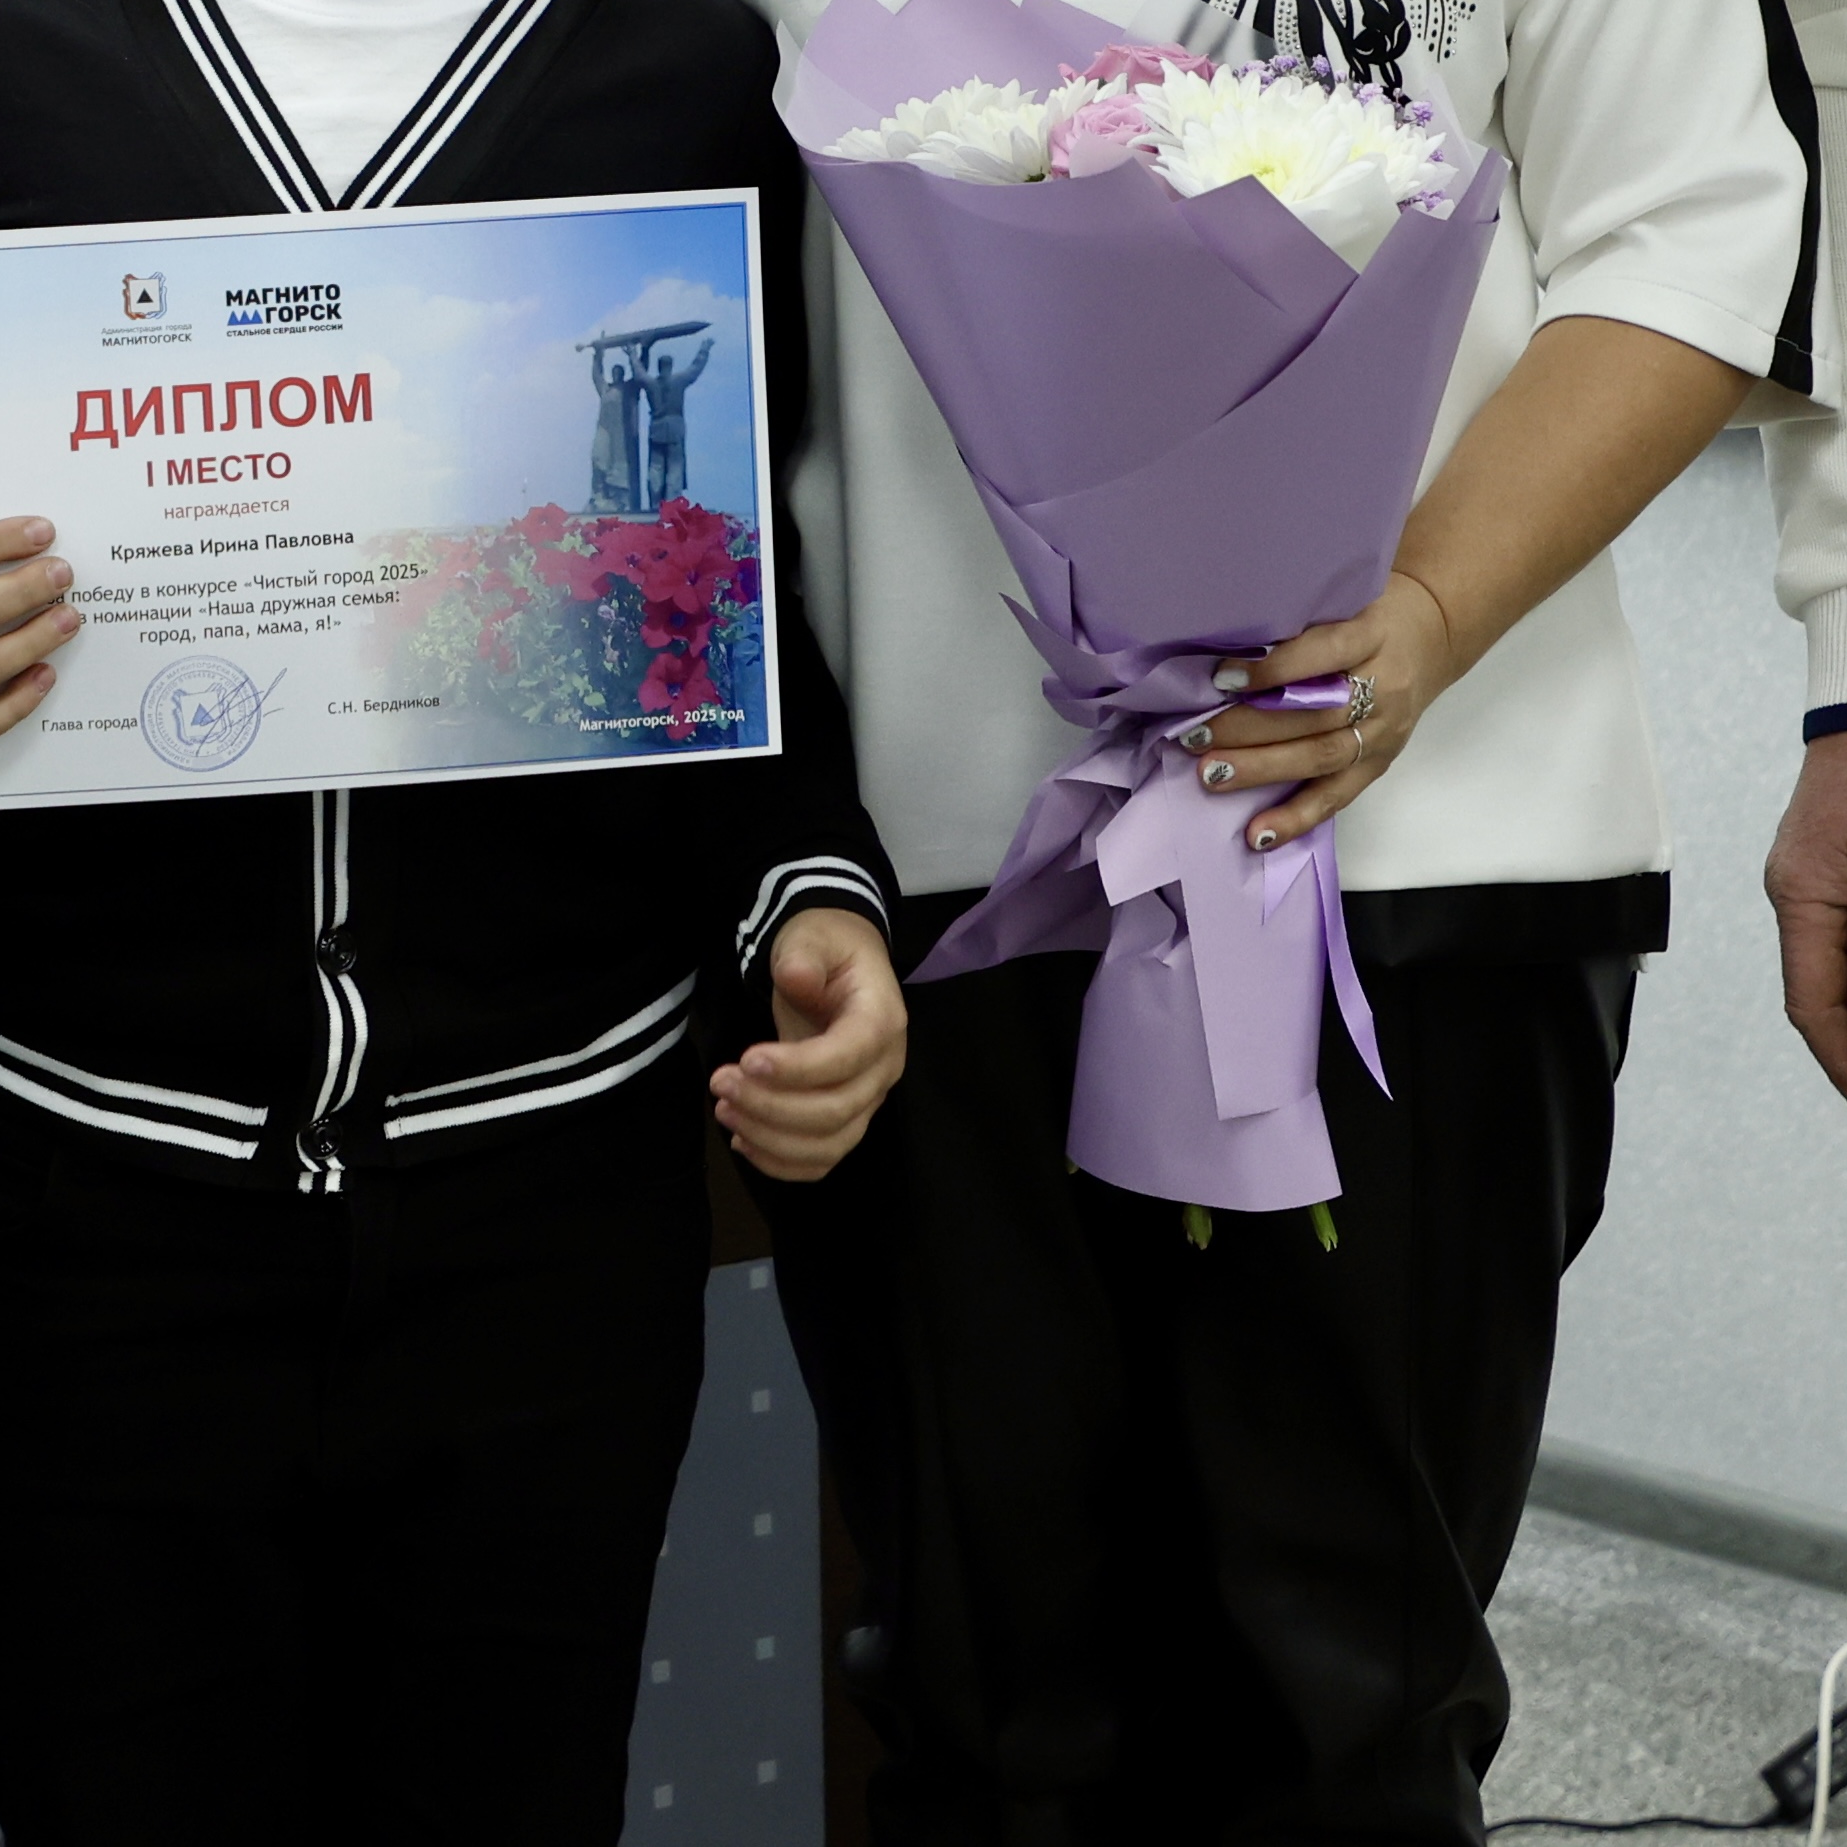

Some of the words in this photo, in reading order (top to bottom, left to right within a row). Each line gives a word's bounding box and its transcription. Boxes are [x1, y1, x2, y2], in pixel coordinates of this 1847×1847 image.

[225, 284, 341, 307] МАГНИТО
[265, 303, 342, 323] ГОРСК
[101, 325, 162, 335] Администрация
[166, 323, 192, 333] города
[102, 333, 192, 347] МАГНИТОГОРСК
[226, 328, 271, 337] СТАЛЬНОЕ
[273, 326, 307, 335] СЕРДЦЕ
[308, 324, 343, 333] РОССИИ
[70, 373, 372, 451] ДИПЛОМ
[166, 452, 292, 486] МЕСТО
[164, 499, 290, 521] награждается
[111, 544, 194, 563] Кряжева
[201, 538, 259, 557] Ирина
[266, 532, 354, 550] Павловна
[72, 586, 134, 603] победу
[141, 586, 150, 598] в
[157, 580, 237, 598] конкурсе
[244, 569, 317, 590] «Чистый
[323, 570, 374, 587] город
[380, 563, 428, 581] 2025»
[93, 606, 192, 624] номинации
[199, 600, 255, 616] «Наша
[261, 595, 336, 615] дружная
[342, 590, 400, 607] семья:
[140, 629, 196, 646] город,
[204, 624, 250, 639] папа,
[257, 620, 308, 635] мама,
[315, 615, 341, 631] я!»
[327, 701, 357, 714] С.Н.
[364, 697, 440, 713] Бердников
[42, 719, 83, 731] Глава
[88, 718, 138, 731] города
[579, 713, 679, 732] Магнитогорск,
[684, 709, 717, 724] 2025
[721, 709, 745, 722] год
